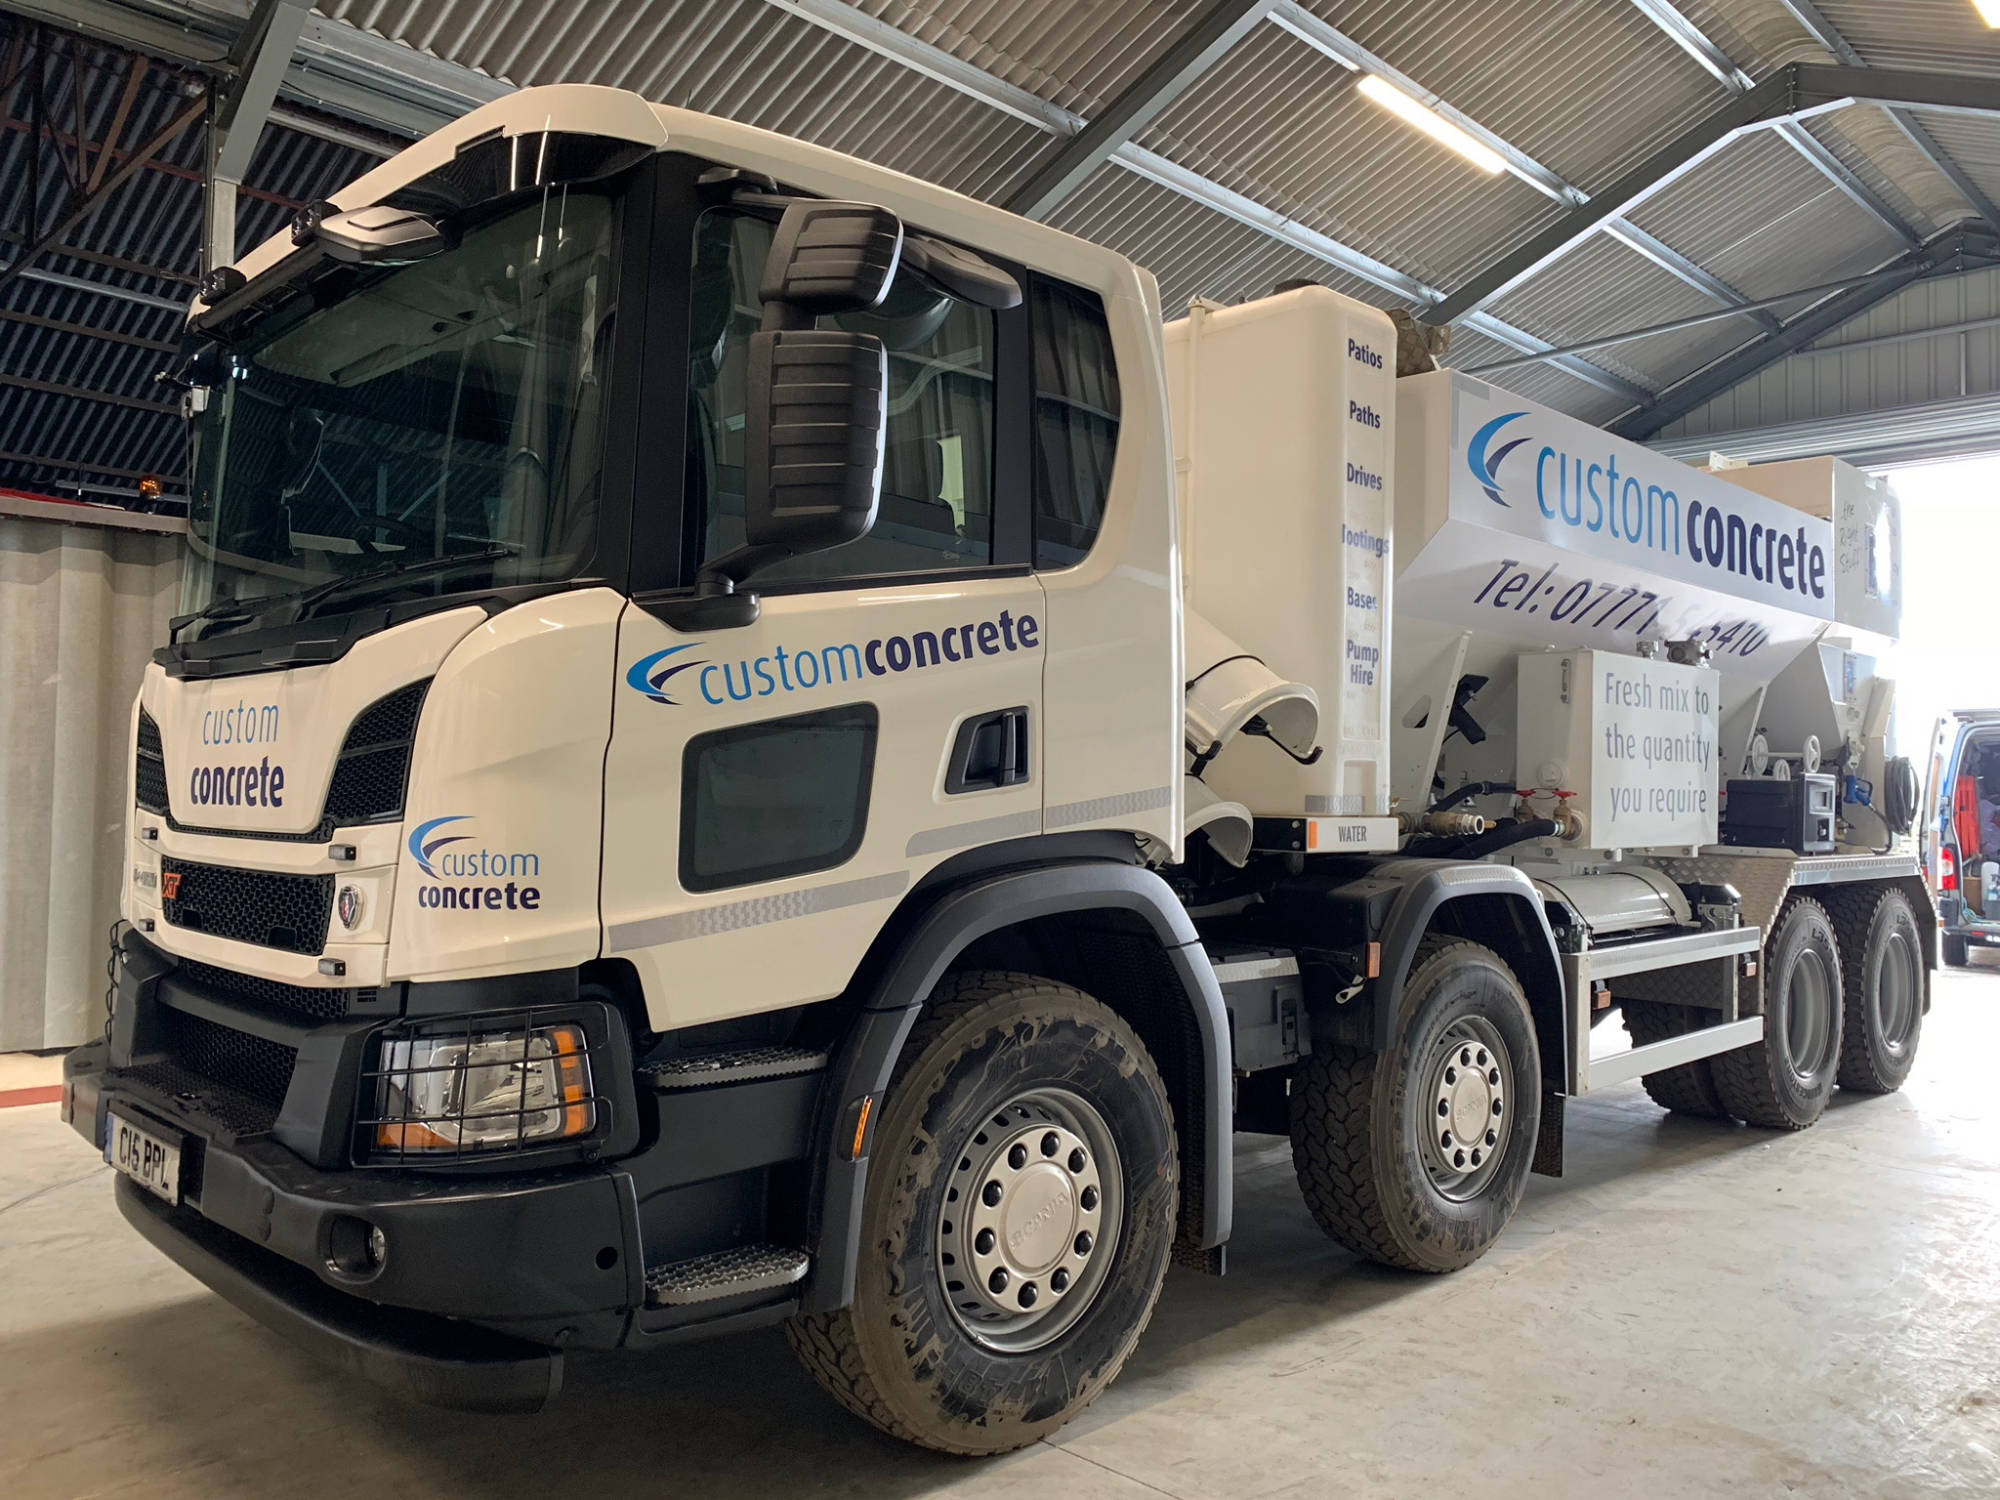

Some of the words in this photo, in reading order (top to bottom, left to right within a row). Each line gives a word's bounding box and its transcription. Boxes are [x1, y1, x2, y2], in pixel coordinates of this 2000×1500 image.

[1348, 338, 1382, 369] Patios
[1350, 400, 1381, 429] Paths
[1347, 462, 1382, 490] Drives
[1474, 558, 1559, 614] Tel:
[1347, 640, 1379, 668] Pump
[1350, 664, 1374, 686] Hire
[1605, 672, 1652, 708] Fresh
[1660, 679, 1689, 712] mix
[1695, 685, 1709, 715] to
[203, 699, 279, 744] custom
[1605, 722, 1636, 760] the
[1643, 731, 1710, 772] quantity
[190, 756, 284, 807] concrete
[1610, 787, 1642, 822] you
[1649, 781, 1707, 821] require
[1338, 825, 1368, 842] WATER
[442, 849, 539, 876] custom
[418, 882, 540, 910] concrete
[119, 1126, 141, 1172] C15
[143, 1139, 169, 1191] BPL
